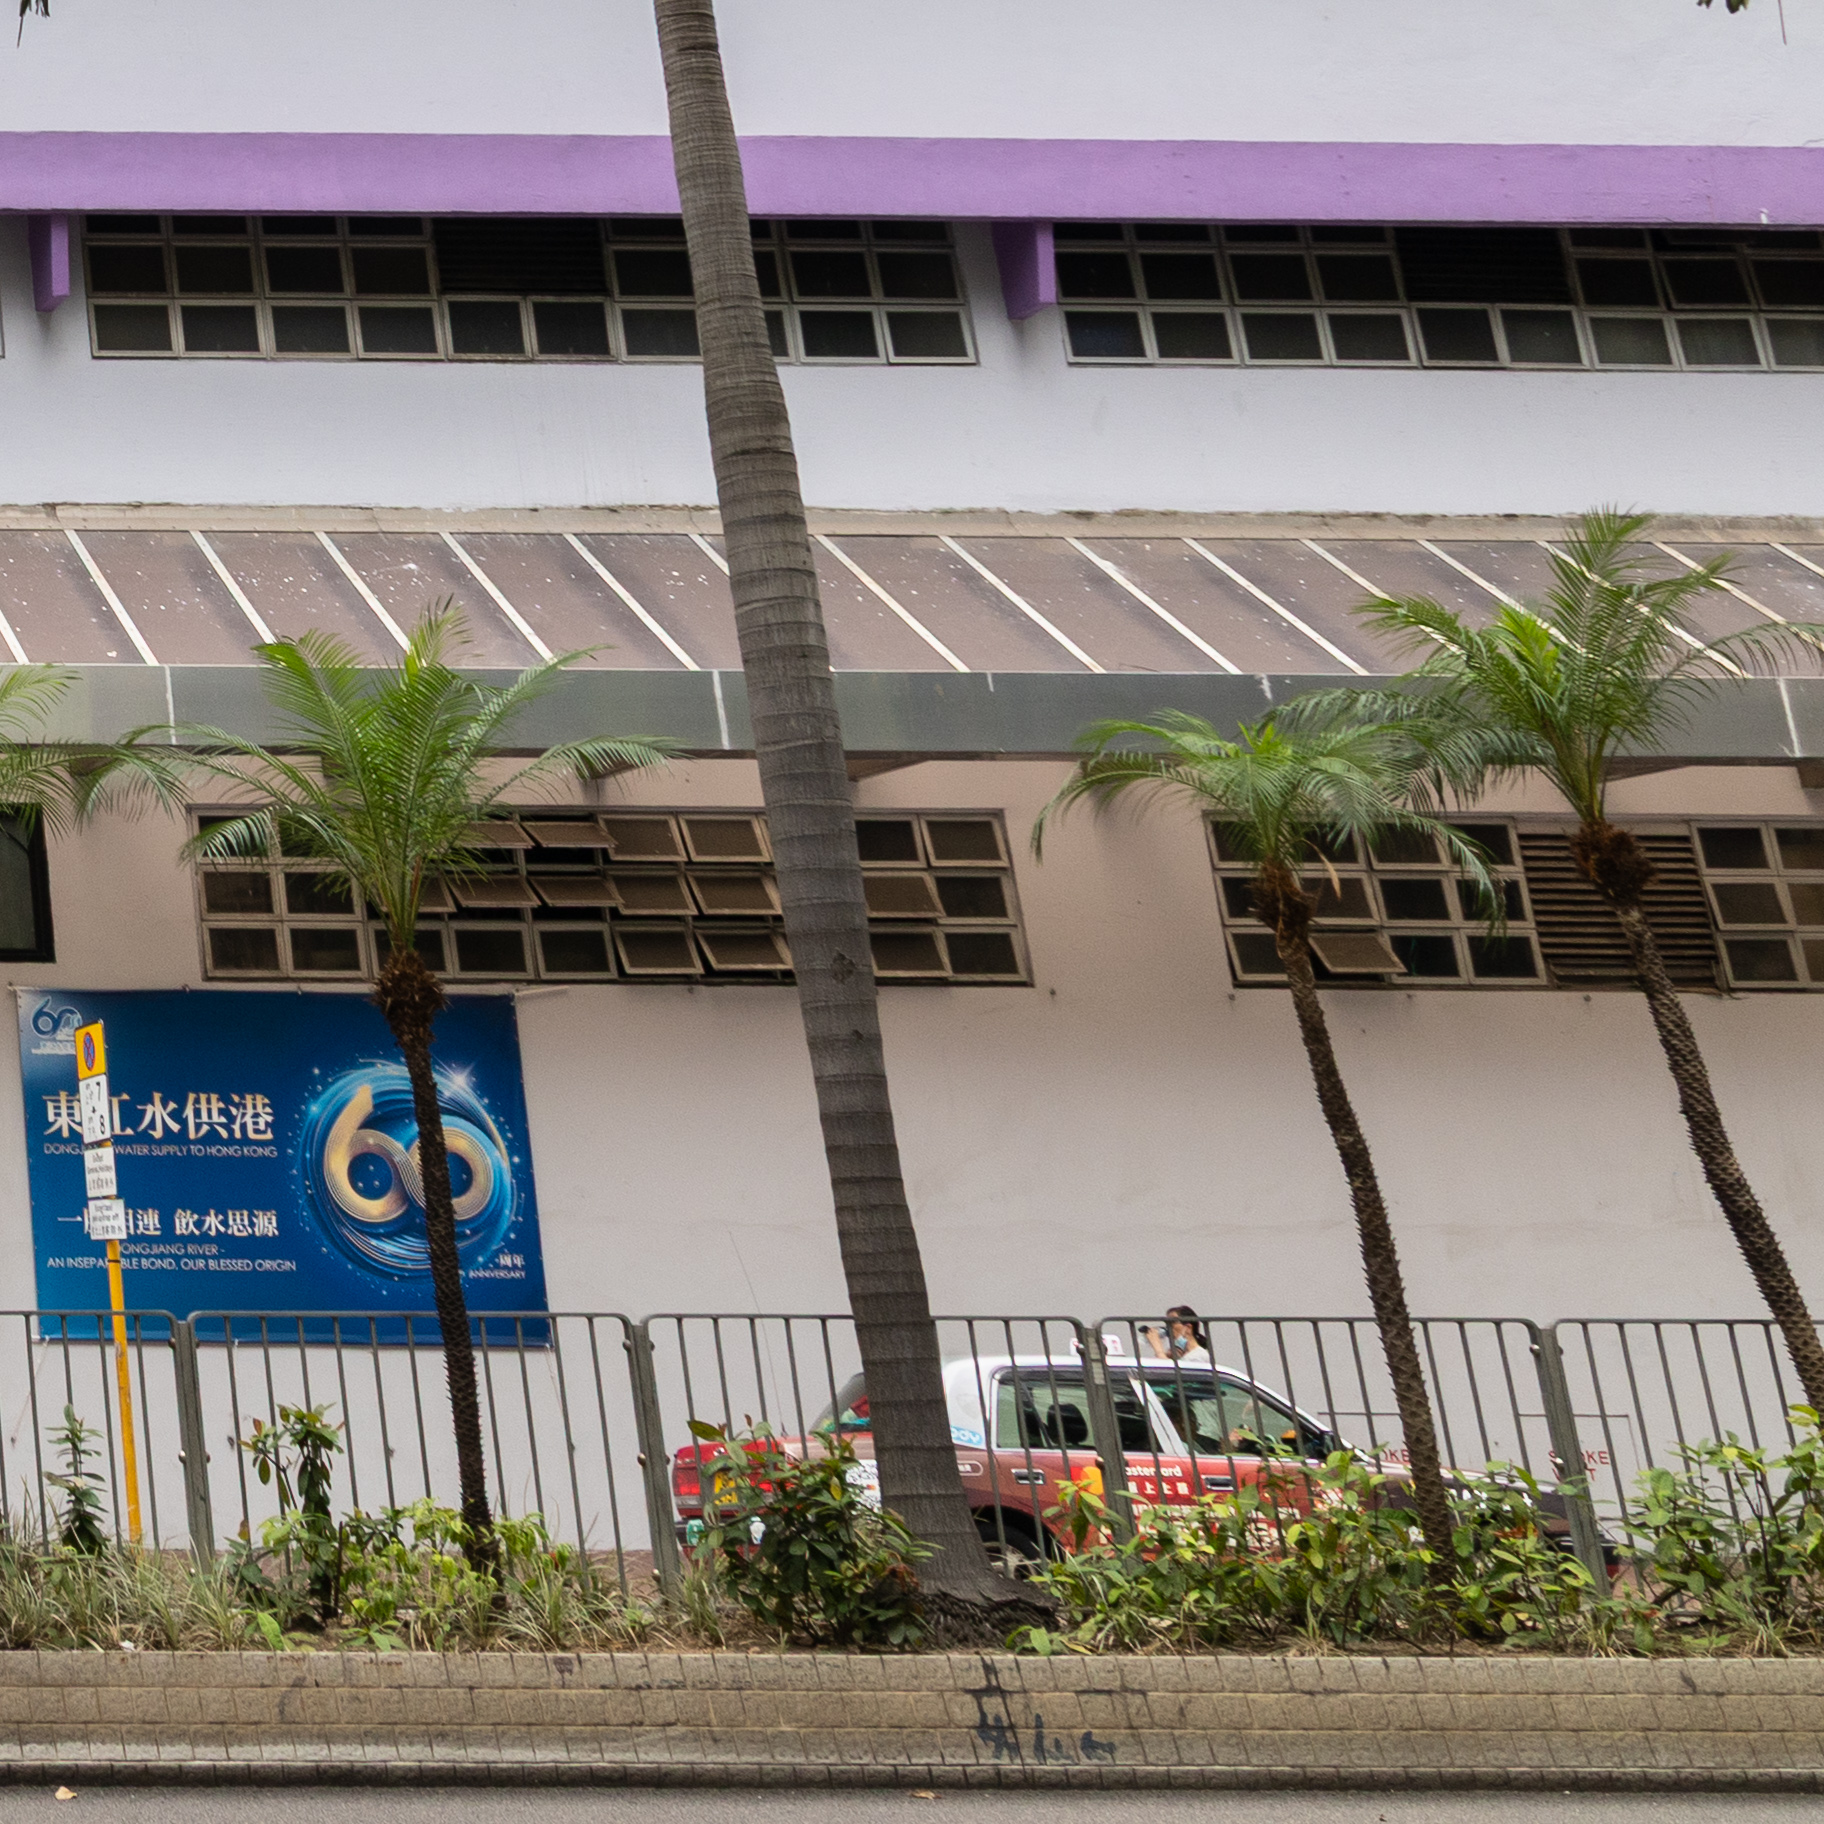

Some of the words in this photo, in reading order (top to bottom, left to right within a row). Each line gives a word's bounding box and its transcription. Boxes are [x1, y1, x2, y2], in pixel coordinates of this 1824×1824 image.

[41, 1089, 275, 1142] 東江水供港
[100, 1114, 106, 1135] 8
[115, 1144, 151, 1156] WATER
[152, 1144, 187, 1157] SUPPLY
[190, 1145, 205, 1157] TO
[207, 1145, 242, 1158] HONG
[244, 1146, 278, 1158] KONG
[173, 1207, 280, 1237] 飲水思源
[118, 1242, 185, 1256] ONGJIANG
[187, 1243, 219, 1256] RIVER
[47, 1257, 65, 1269] AN
[66, 1257, 139, 1270] INSEPABLE
[181, 1259, 207, 1271] OUR
[208, 1259, 253, 1272] BLESSED
[254, 1260, 297, 1272] ORIGIN
